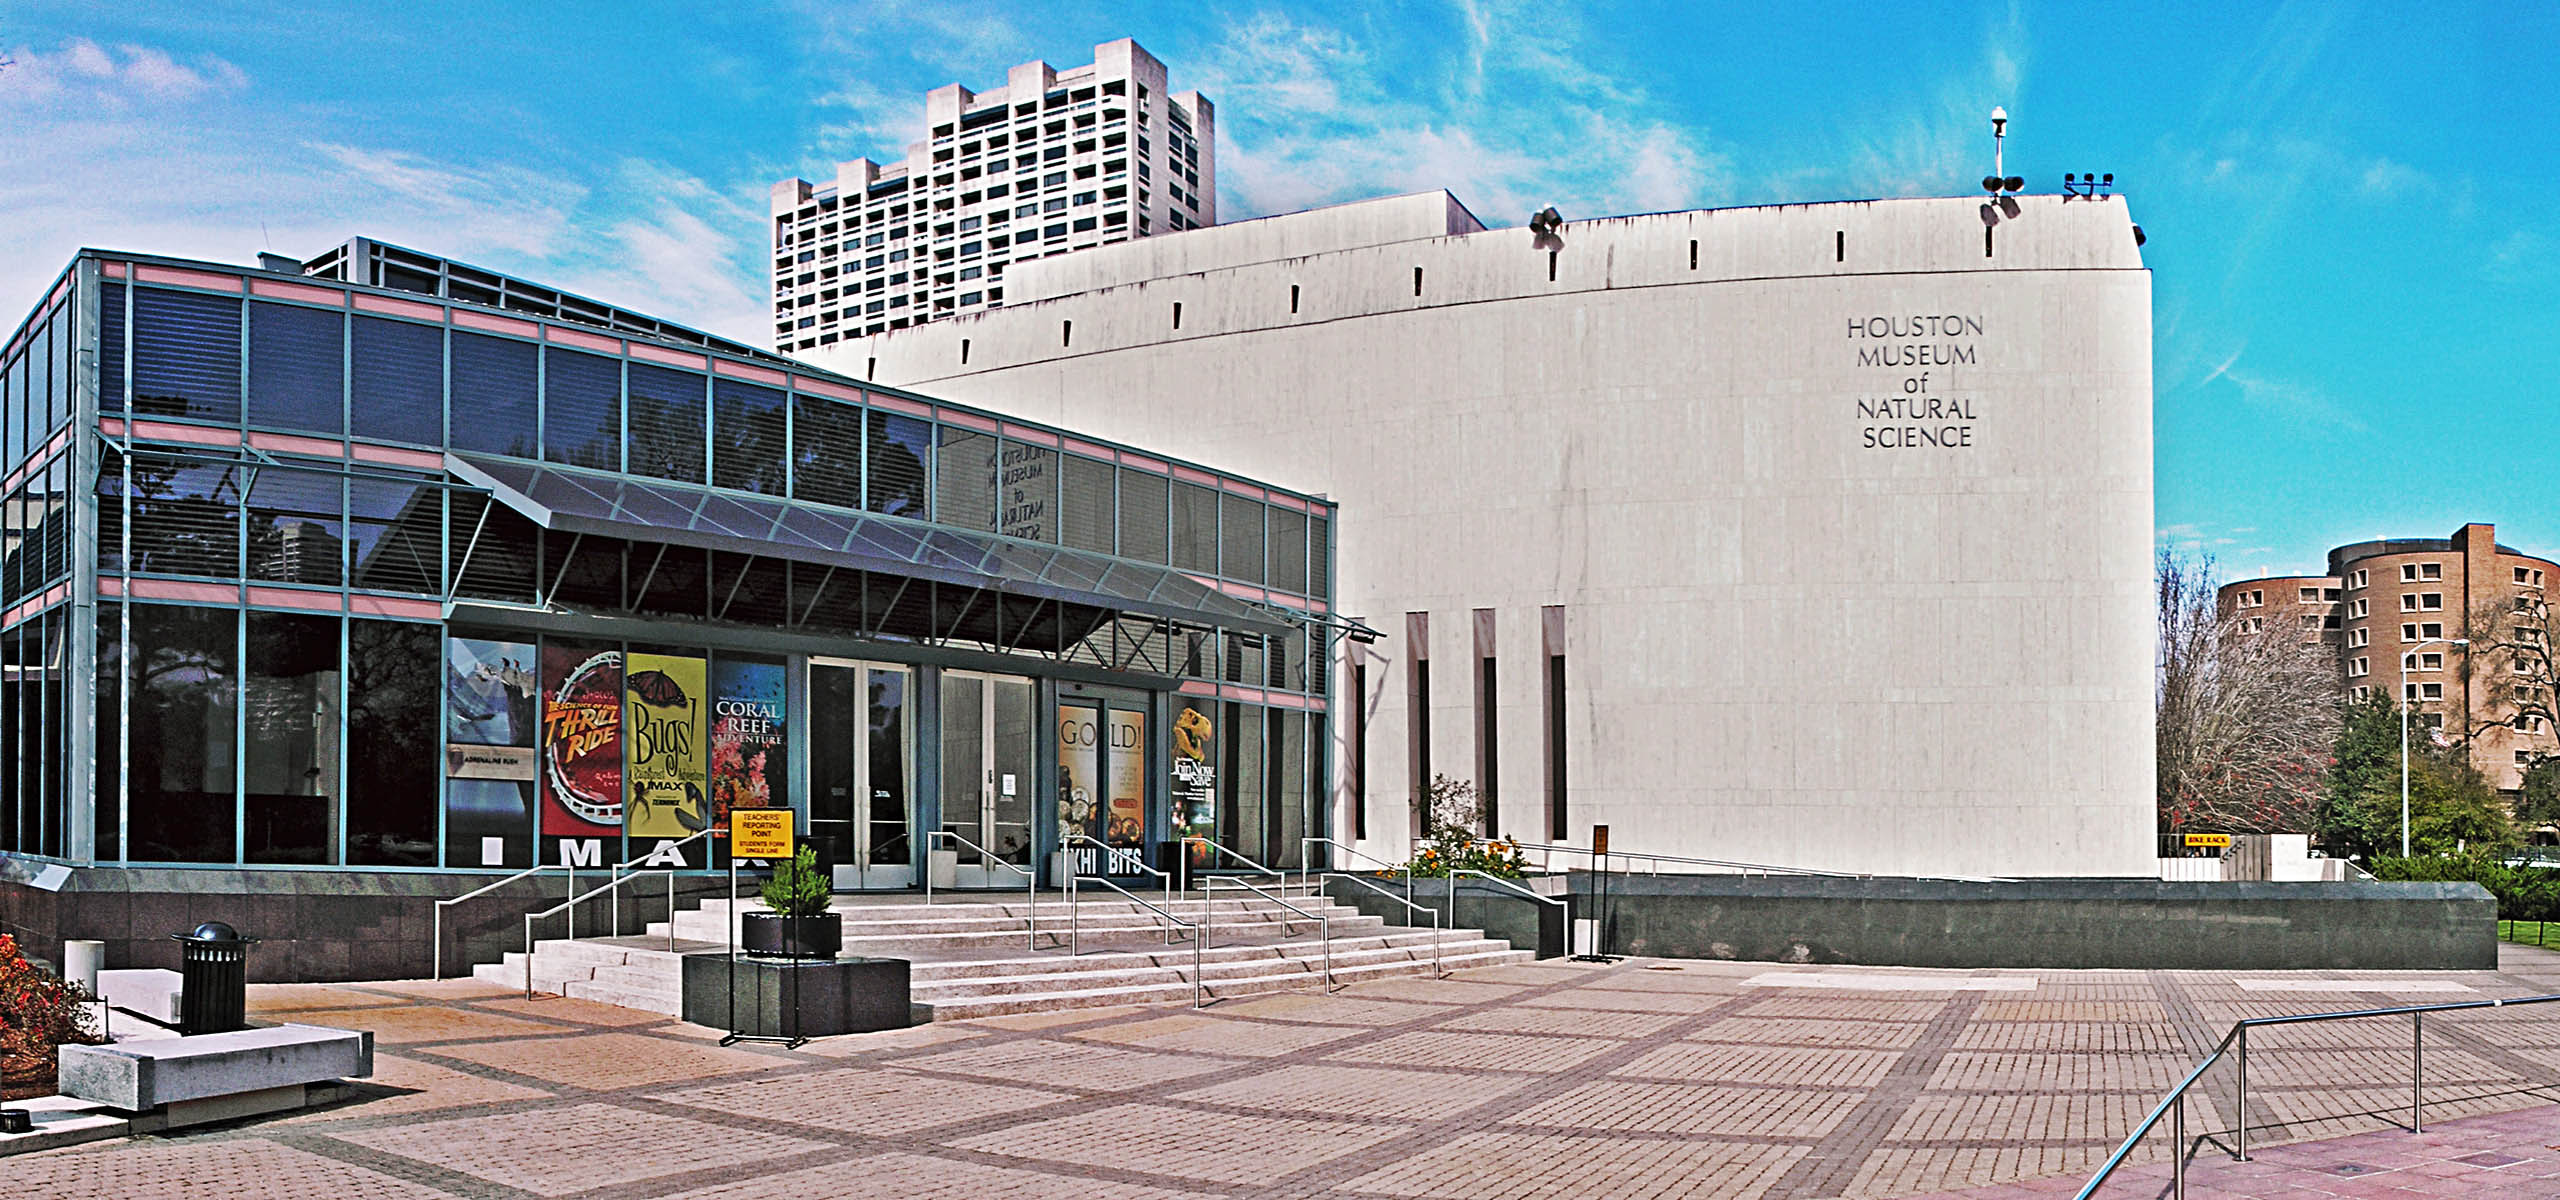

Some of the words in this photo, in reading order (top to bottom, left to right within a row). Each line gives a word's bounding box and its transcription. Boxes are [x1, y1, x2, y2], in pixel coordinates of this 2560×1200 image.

[1847, 315, 1984, 338] HOUSTON
[1857, 344, 1976, 367] MUSEUM
[1904, 371, 1929, 393] of
[1857, 398, 1977, 419] NATURAL
[1863, 426, 1972, 448] SCIENCE
[716, 701, 780, 718] CORAL
[544, 709, 619, 748] THRILL
[728, 717, 771, 734] REEF
[1061, 720, 1142, 749] GOLD!
[566, 726, 617, 764] RIDE
[632, 698, 697, 777] Bugs!
[715, 733, 782, 745] ADVENTURE
[1170, 757, 1193, 776] Join
[1190, 761, 1216, 778] Now
[648, 781, 683, 791] IMAX
[1189, 775, 1212, 787] Save
